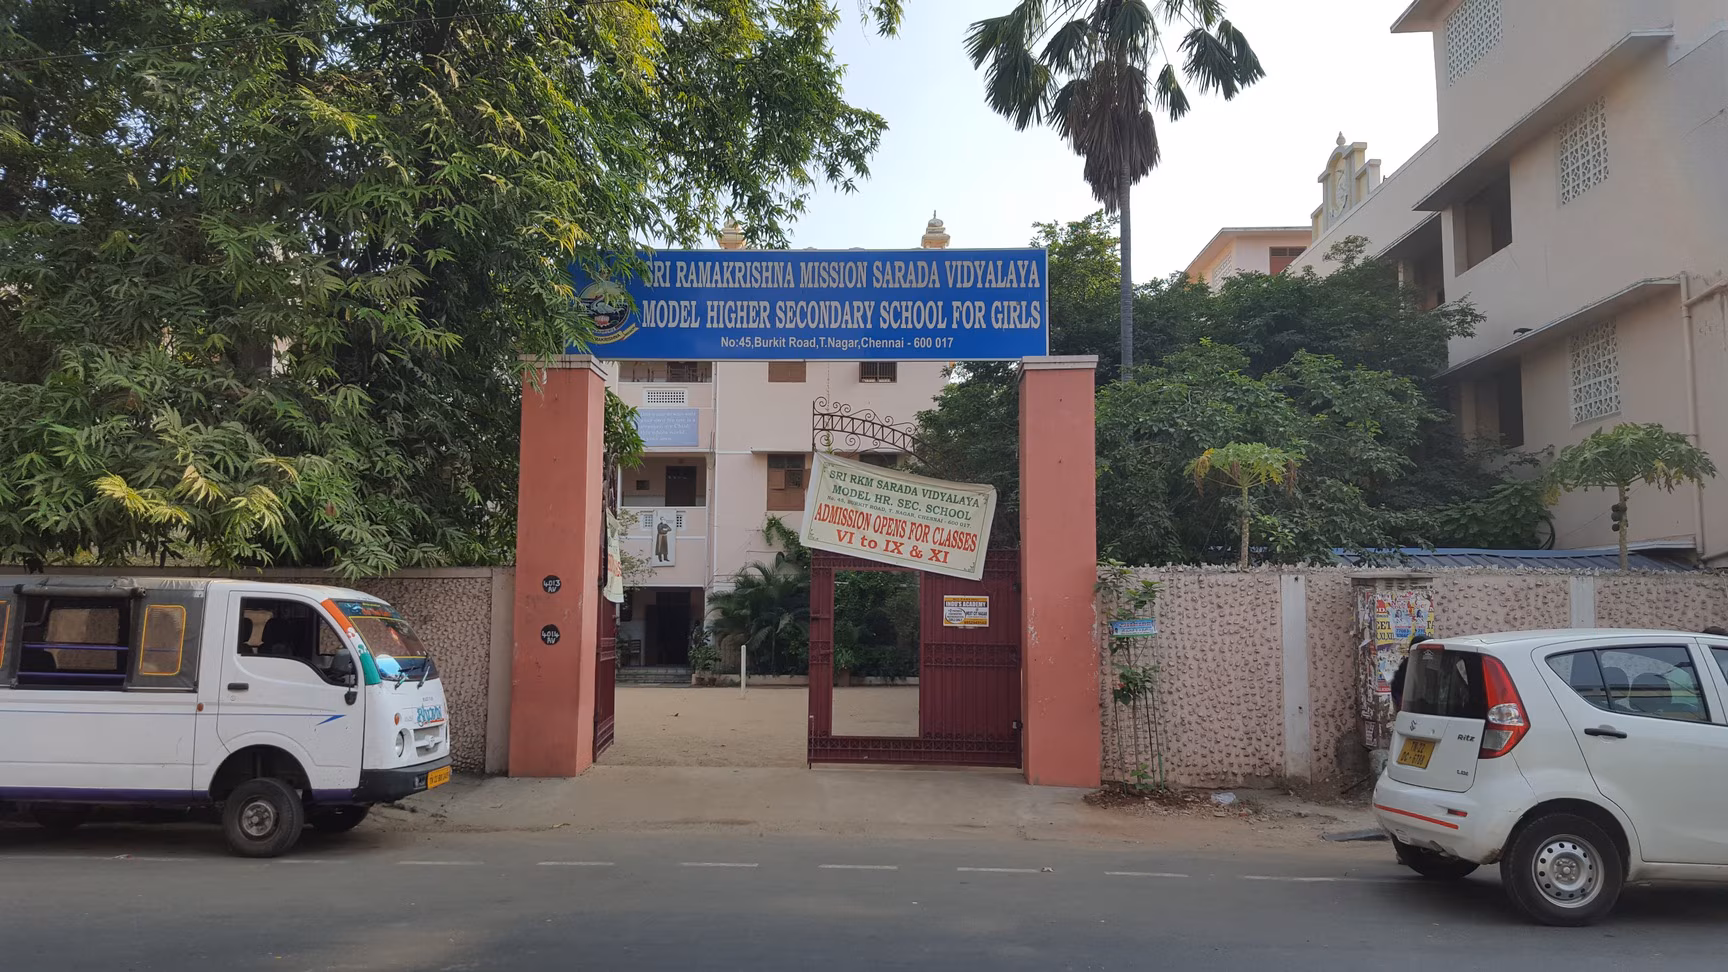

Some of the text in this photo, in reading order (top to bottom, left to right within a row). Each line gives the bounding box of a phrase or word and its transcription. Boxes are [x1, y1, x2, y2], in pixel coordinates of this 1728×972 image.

[676, 261, 794, 288] RAMAKRISHNA
[800, 261, 867, 288] MISSION
[872, 260, 940, 288] SARADA
[944, 260, 1040, 288] VIDYALAYA
[642, 300, 1041, 329] MODEL HIGHER SECONDARY SCHOOL FOR GIRLS
[914, 338, 932, 348] 600
[935, 338, 954, 348] 017
[829, 470, 980, 508] SRI RKM SARADA VIDYALAYA
[832, 484, 972, 520] MODEL HR. SEC. SCHOOL
[814, 502, 977, 553] ADMISSION OPENS FOR CLASSES
[918, 514, 943, 523] CHENNAI
[836, 529, 949, 564] VI to IX & XI
[1457, 734, 1475, 742] Ritz
